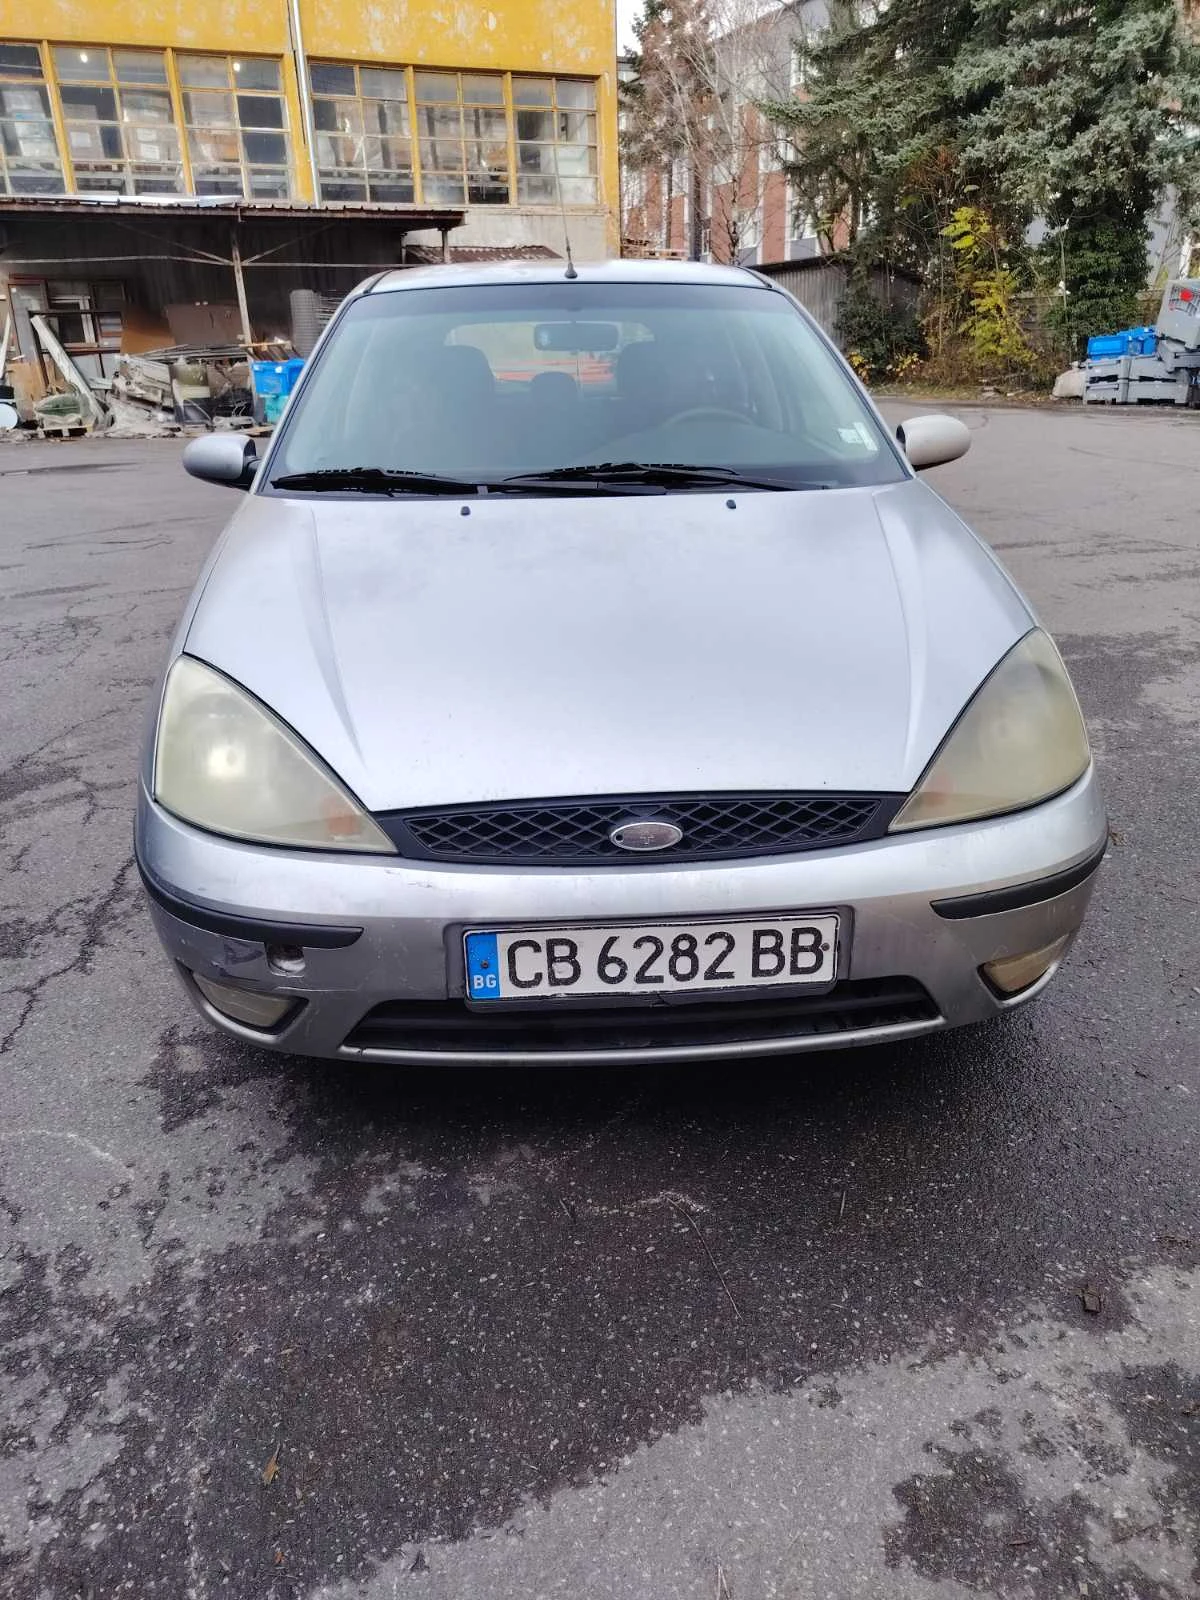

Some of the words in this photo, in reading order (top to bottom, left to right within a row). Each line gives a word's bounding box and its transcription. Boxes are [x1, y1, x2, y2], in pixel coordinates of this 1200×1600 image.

[507, 938, 582, 989] CB
[597, 931, 736, 985] 6282
[751, 926, 824, 978] BB
[473, 974, 497, 990] BG
